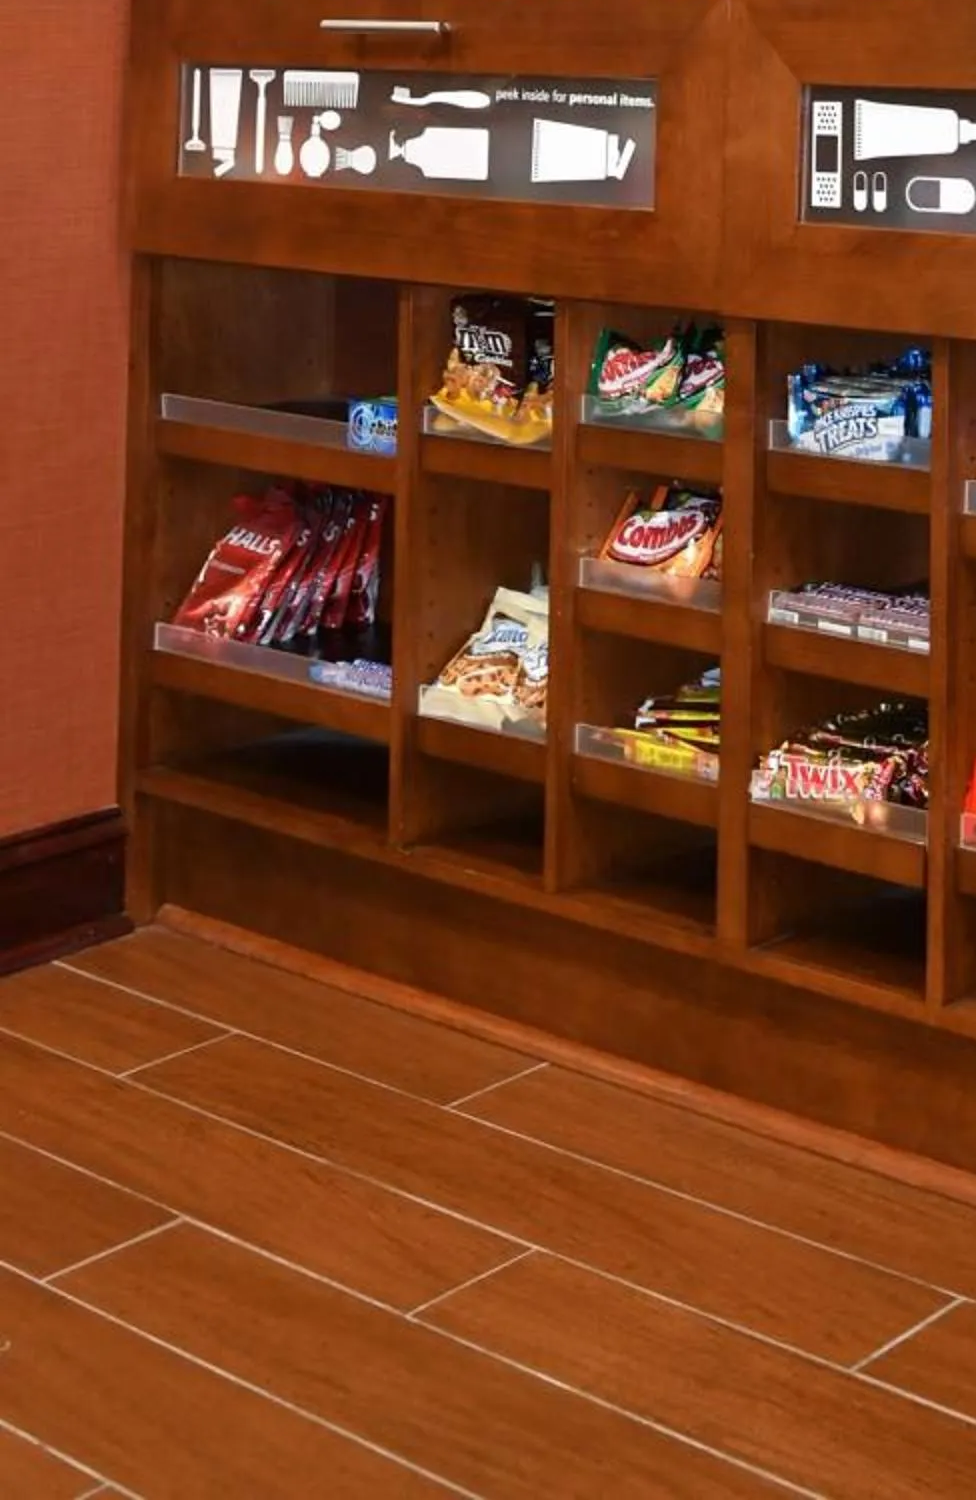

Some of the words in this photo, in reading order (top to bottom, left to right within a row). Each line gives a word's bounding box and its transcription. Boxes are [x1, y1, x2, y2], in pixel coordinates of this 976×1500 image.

[495, 88, 519, 103] peek
[521, 88, 550, 102] inside
[552, 89, 567, 103] for
[569, 91, 617, 107] personal
[619, 93, 656, 108] items.
[815, 417, 878, 454] TREATS
[226, 526, 282, 555] HALLS
